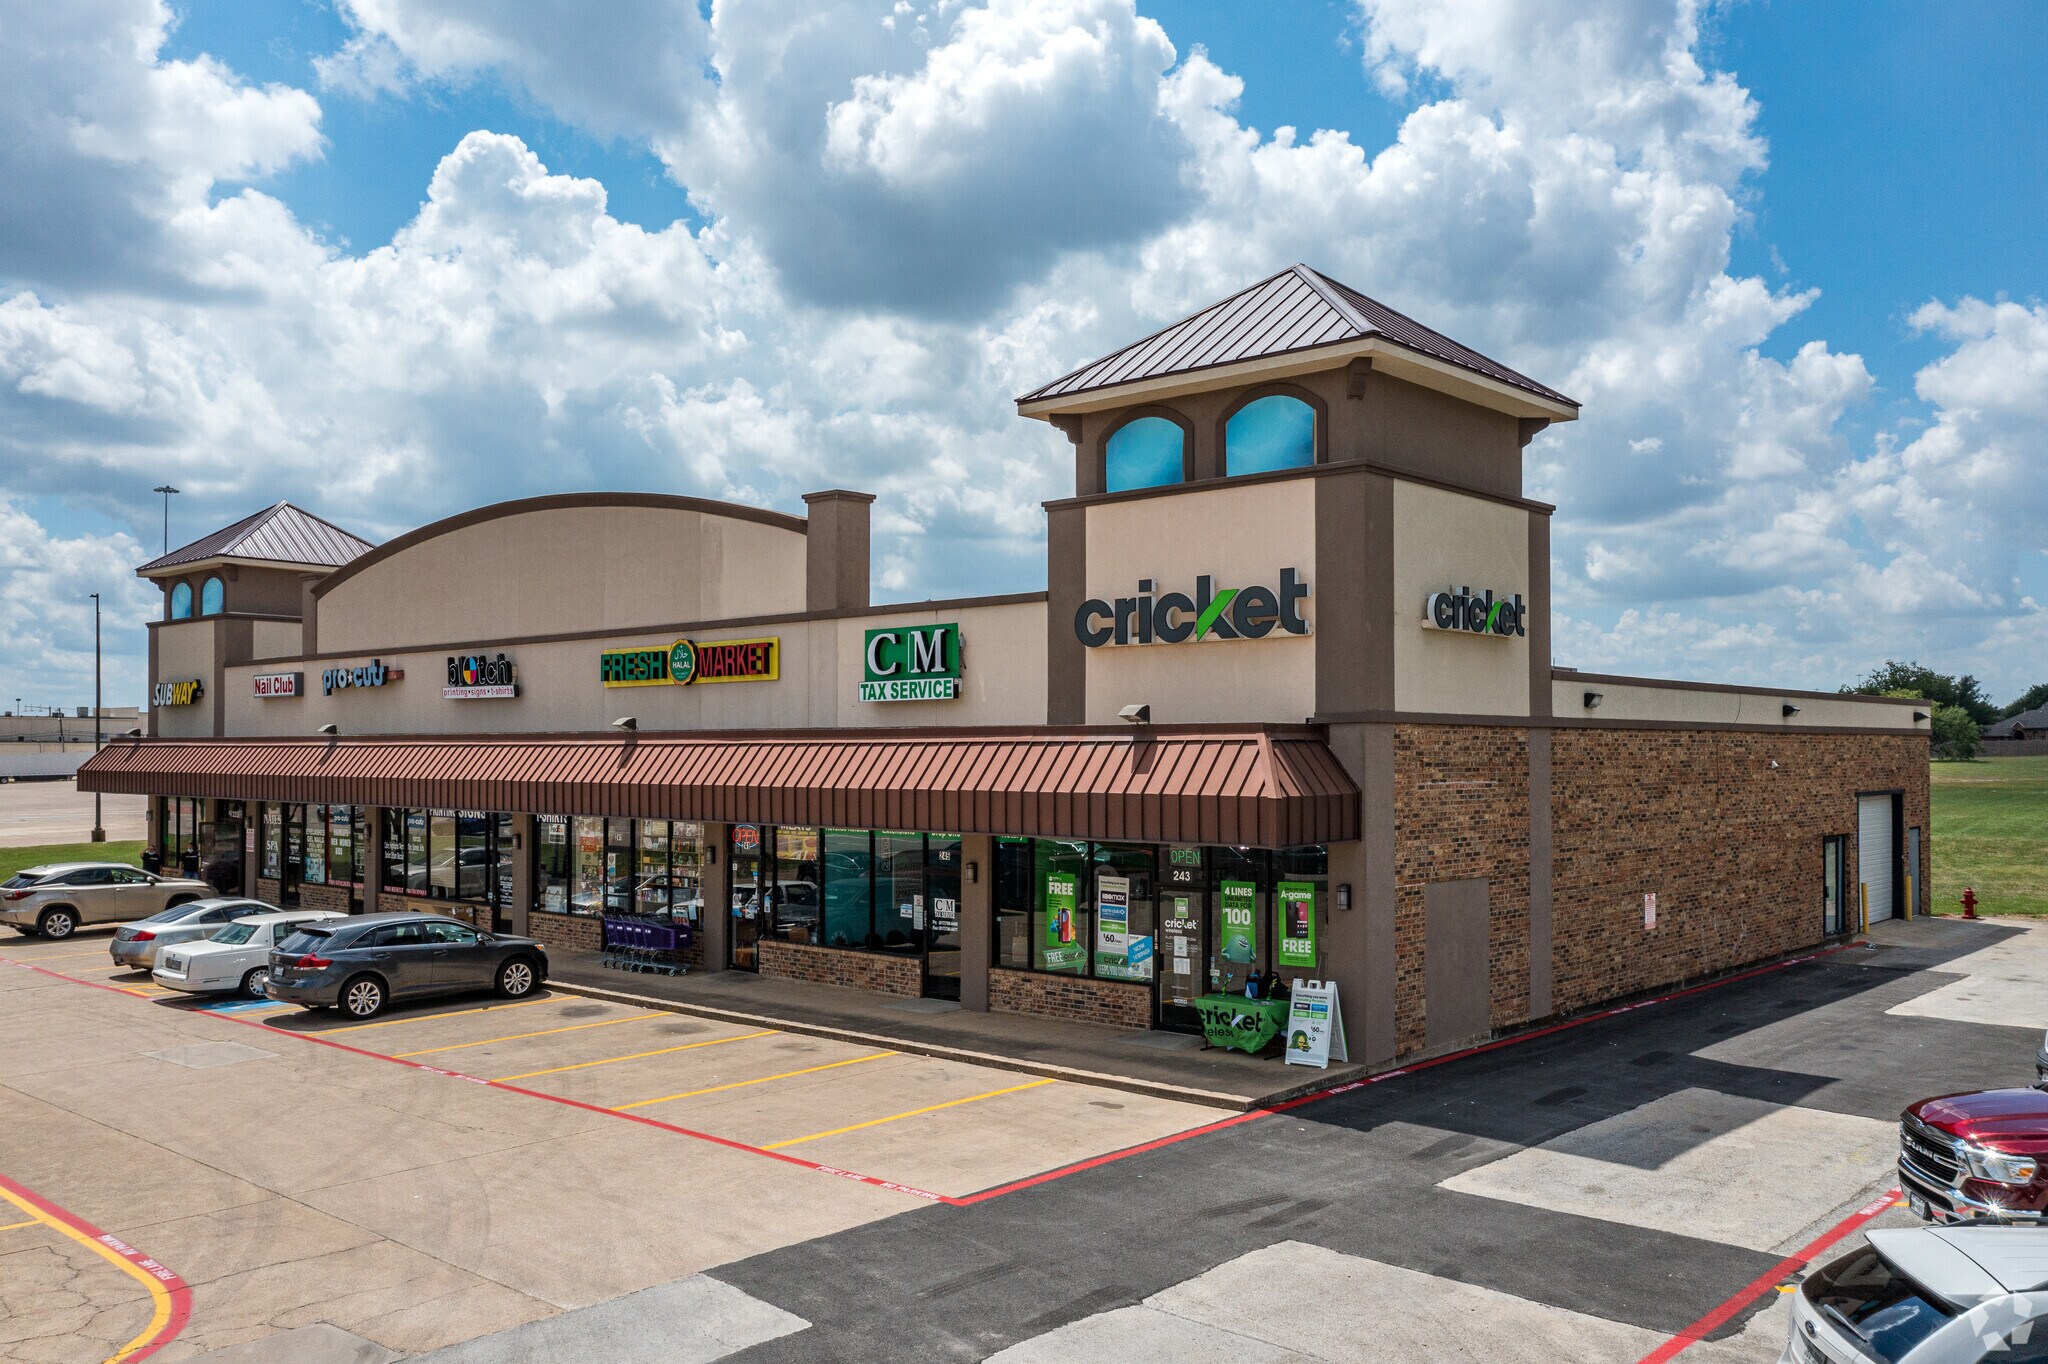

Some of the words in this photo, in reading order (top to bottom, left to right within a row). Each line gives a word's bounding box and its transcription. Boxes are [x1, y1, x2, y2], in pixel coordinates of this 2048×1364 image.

[1074, 567, 1311, 648] cricket
[1430, 586, 1526, 637] cricket
[601, 651, 664, 682] FRESH
[699, 642, 771, 678] MARKET
[672, 661, 691, 669] HALAL
[153, 680, 198, 707] SUBWAY
[254, 677, 272, 695] Nail
[273, 677, 294, 694] Club
[490, 686, 514, 696] t-shirts
[861, 683, 887, 700] TAX
[890, 679, 953, 700] SERVICE
[732, 828, 759, 845] OPEN
[266, 840, 279, 851] SPA
[1170, 849, 1201, 865] OPEN
[1173, 870, 1191, 882] 243
[1048, 882, 1074, 896] FREE
[1224, 886, 1230, 896] 4
[1231, 887, 1253, 897] LINES
[1280, 890, 1312, 900] A-game
[1164, 918, 1197, 930] cricket
[1133, 943, 1146, 952] NOW
[1282, 938, 1312, 954] FREE
[1046, 951, 1064, 964] FREE
[1103, 956, 1128, 966] cricke
[1198, 1005, 1263, 1034] cricket
[815, 1165, 839, 1176] FIRE
[838, 1171, 868, 1182] LANE
[895, 1186, 941, 1200] PARKING
